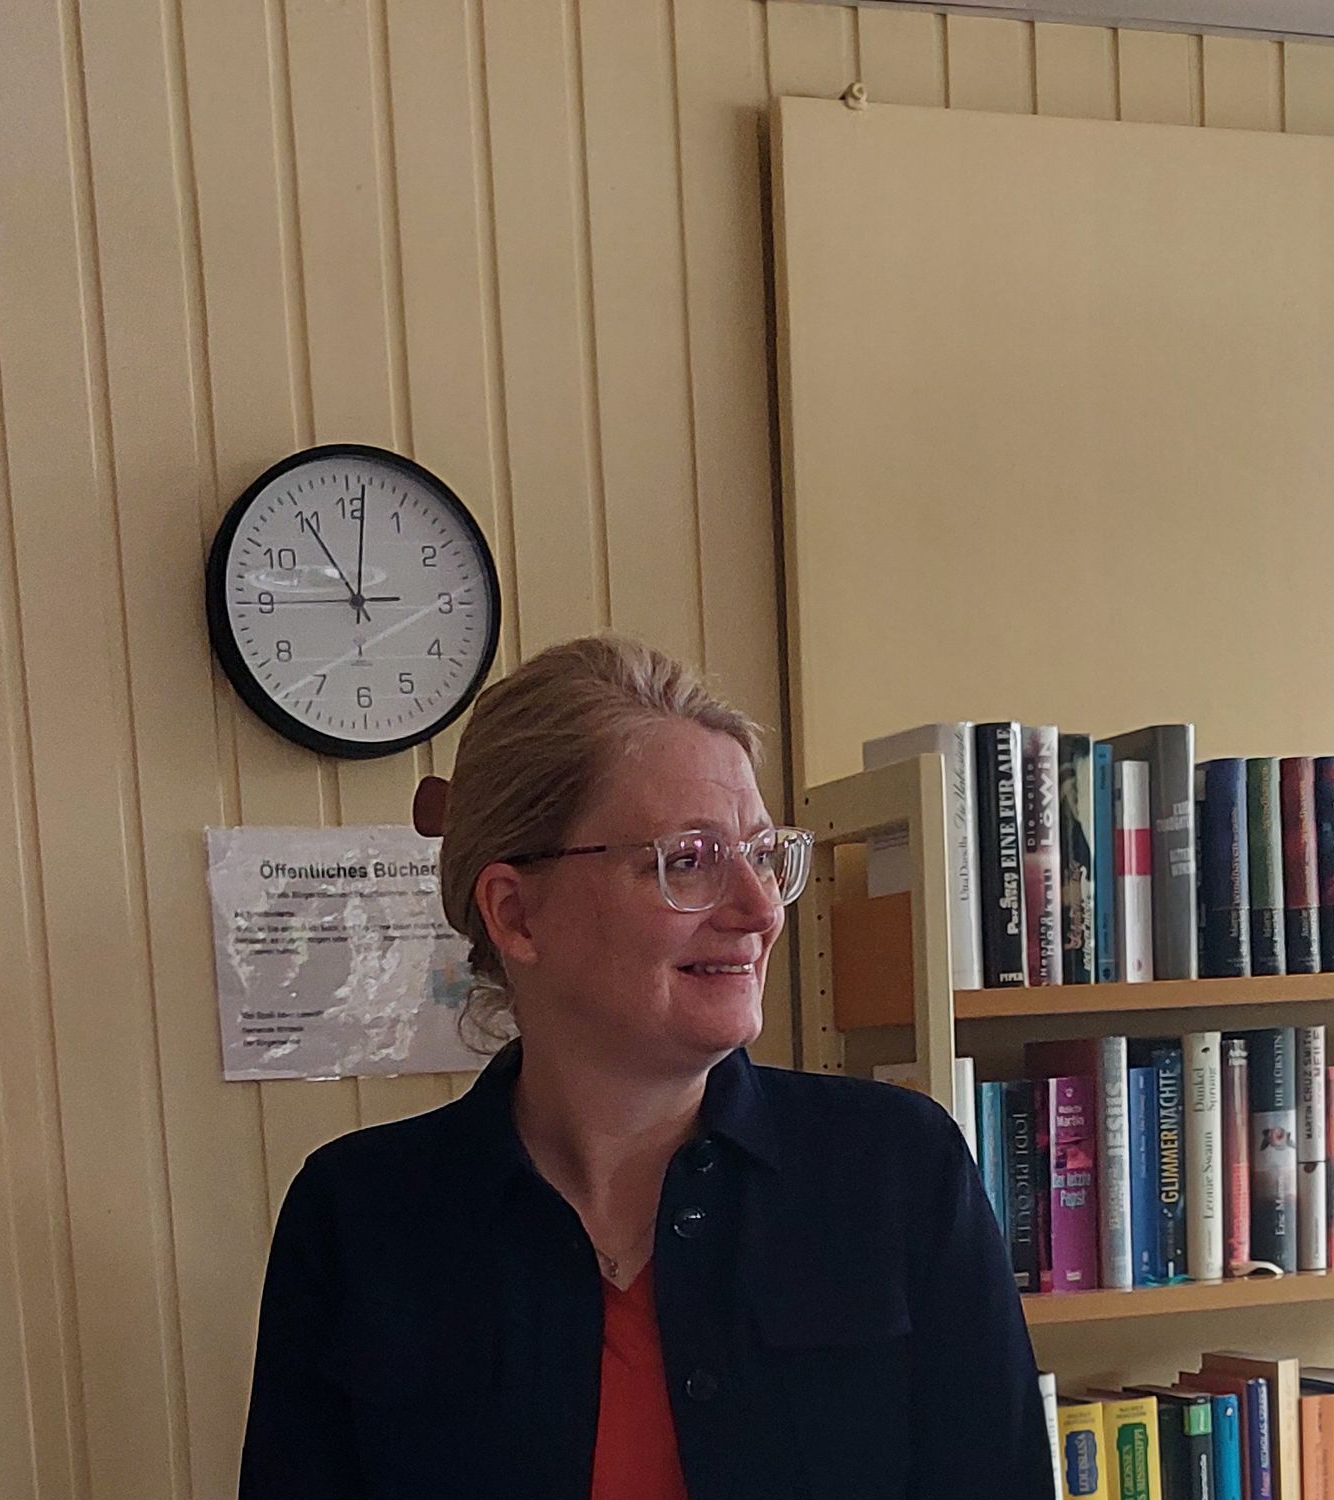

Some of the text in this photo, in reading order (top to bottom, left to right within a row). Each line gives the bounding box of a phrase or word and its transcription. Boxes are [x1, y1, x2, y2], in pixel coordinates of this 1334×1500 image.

[391, 511, 401, 533] 1
[263, 548, 296, 570] 10
[422, 545, 437, 567] 2
[258, 592, 274, 614] 9
[438, 592, 454, 614] 3
[276, 640, 292, 662] 8
[427, 639, 444, 661] 4
[312, 674, 328, 695] 7
[398, 673, 414, 694] 5
[357, 686, 373, 708] 6
[1303, 1070, 1312, 1103] CRUZ
